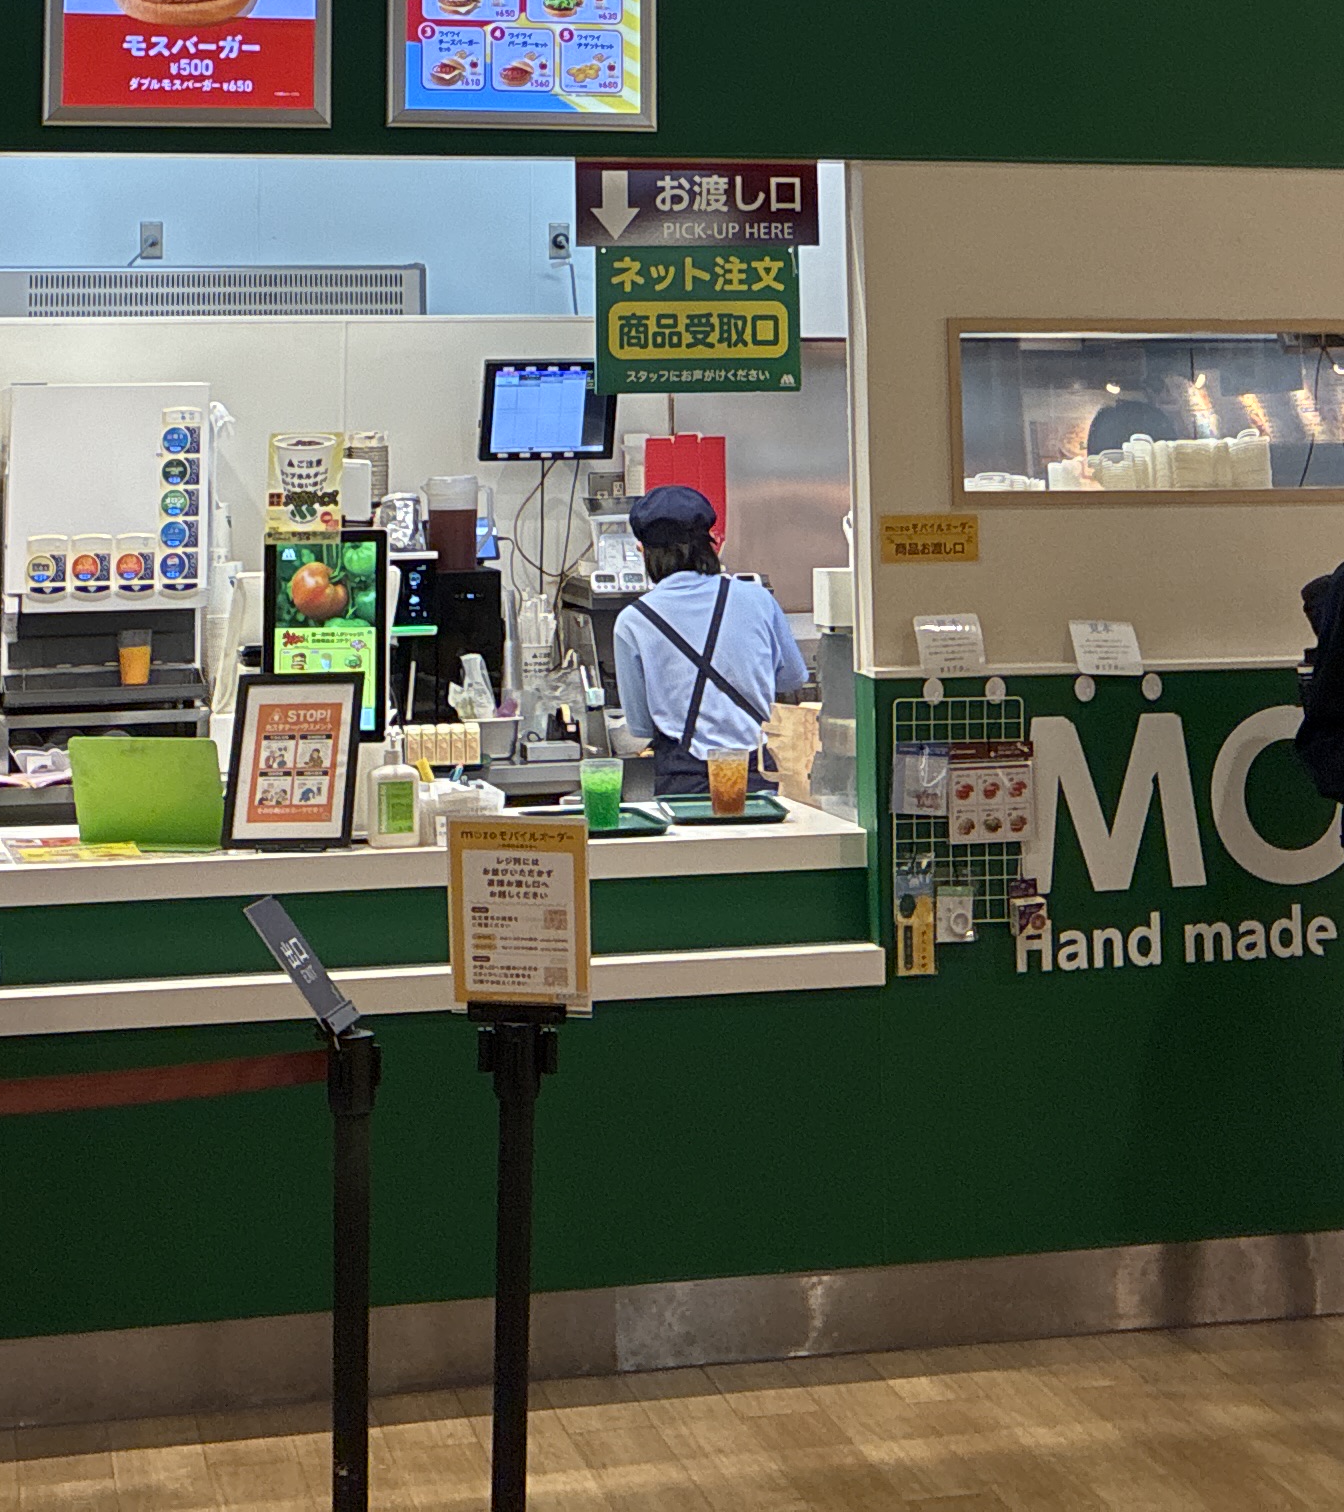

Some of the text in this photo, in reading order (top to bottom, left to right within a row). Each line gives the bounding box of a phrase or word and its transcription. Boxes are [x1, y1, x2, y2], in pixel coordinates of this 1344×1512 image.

[123, 34, 261, 59] モスバーガー
[169, 59, 214, 76] ¥500
[655, 174, 802, 213] お渡し口
[663, 221, 794, 239] PICK-UP HERE
[610, 255, 786, 292] ネット注文
[617, 312, 780, 350] 商品受取口
[626, 369, 771, 383] スタッフにお声がけください
[894, 541, 965, 556] 商品お渡し口
[287, 709, 332, 723] STOP!
[1015, 904, 1339, 974] Hand made
